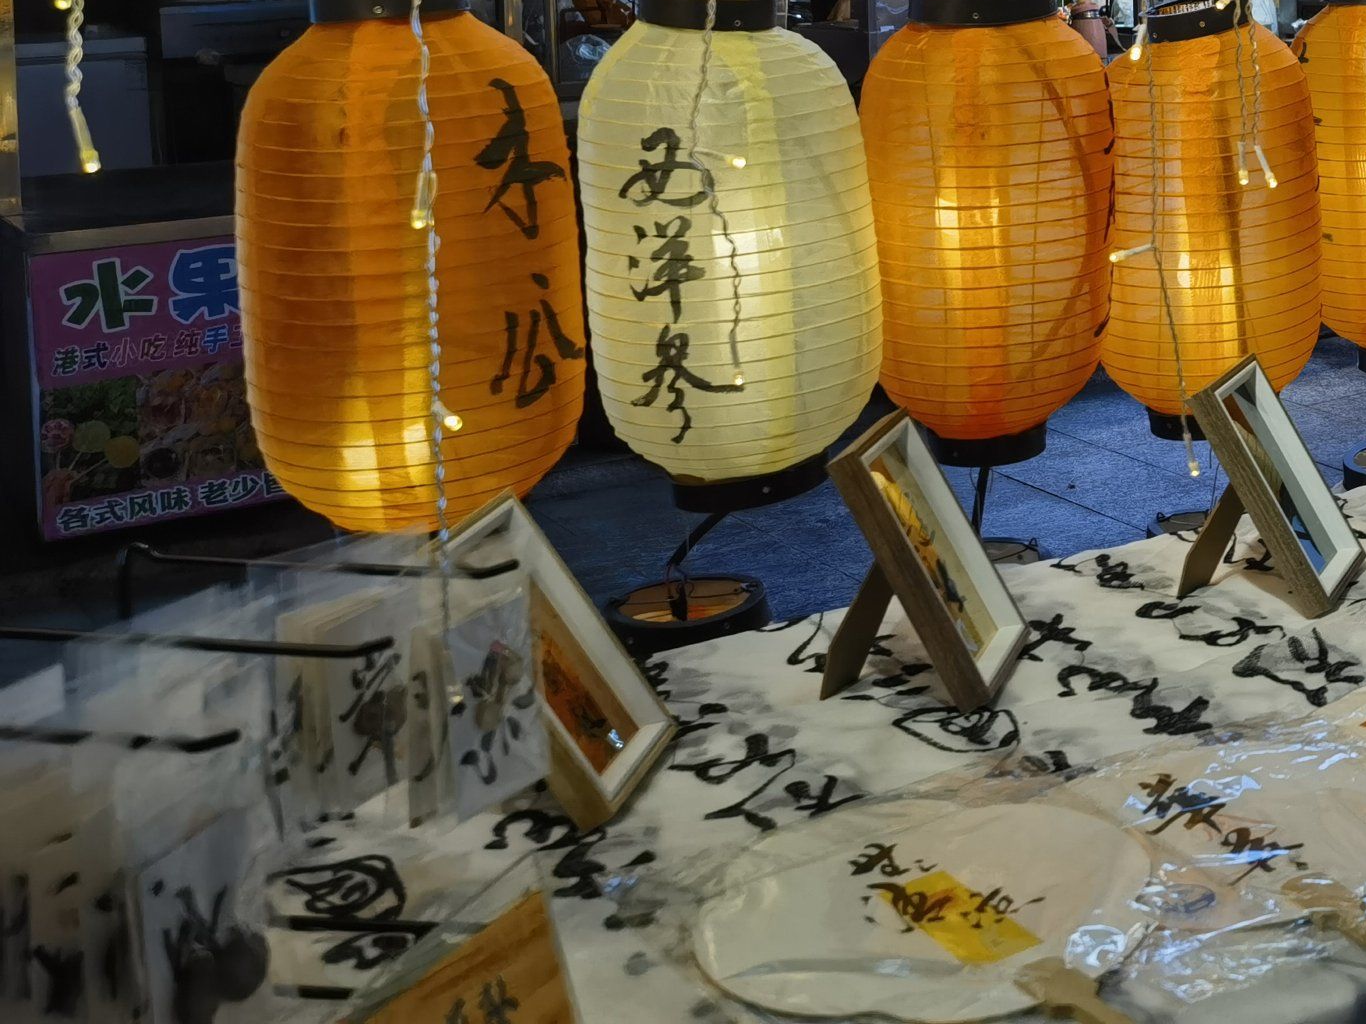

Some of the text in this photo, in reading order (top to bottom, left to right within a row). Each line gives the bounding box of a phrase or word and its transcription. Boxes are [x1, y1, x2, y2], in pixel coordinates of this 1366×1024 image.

[51, 332, 167, 376] 港式小吃
[57, 484, 192, 533] 各式风味
